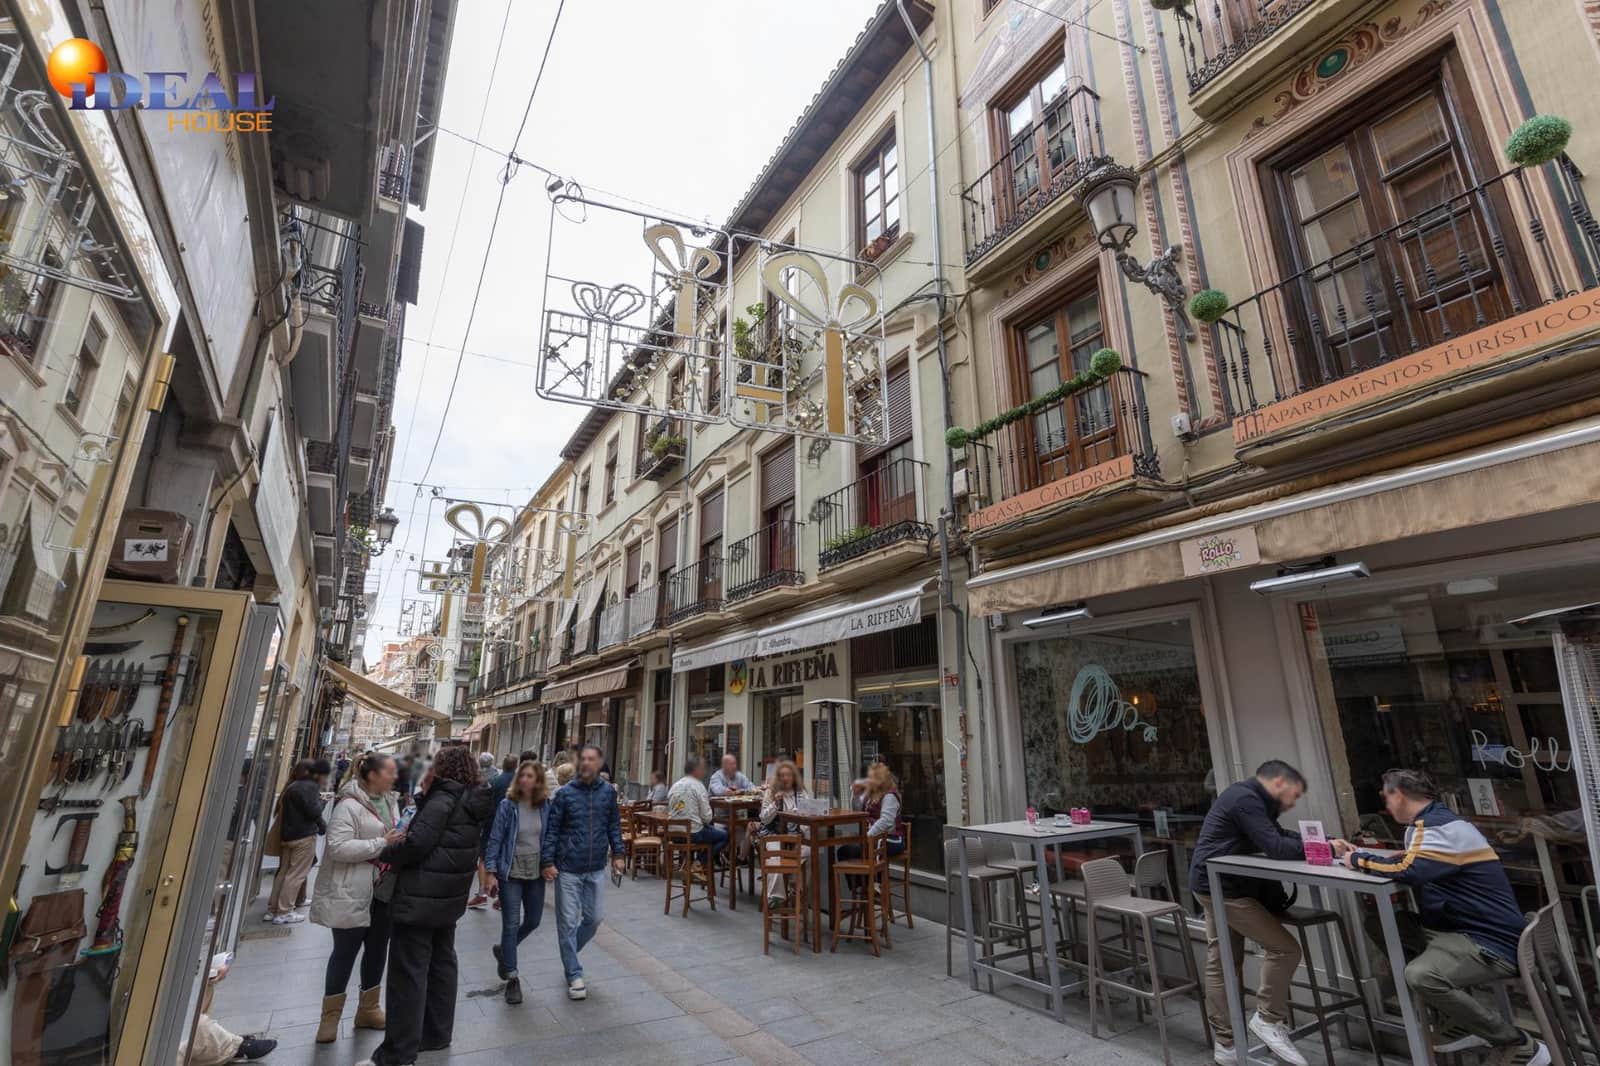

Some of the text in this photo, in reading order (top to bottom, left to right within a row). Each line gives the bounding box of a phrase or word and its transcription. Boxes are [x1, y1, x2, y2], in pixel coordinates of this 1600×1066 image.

[1266, 360, 1433, 426] APARTAMENTOS
[985, 461, 1128, 521] CASA CATEDRAL
[1201, 543, 1234, 561] ROLLO
[851, 604, 913, 630] LA RIFFEÑA
[749, 667, 768, 689] LA
